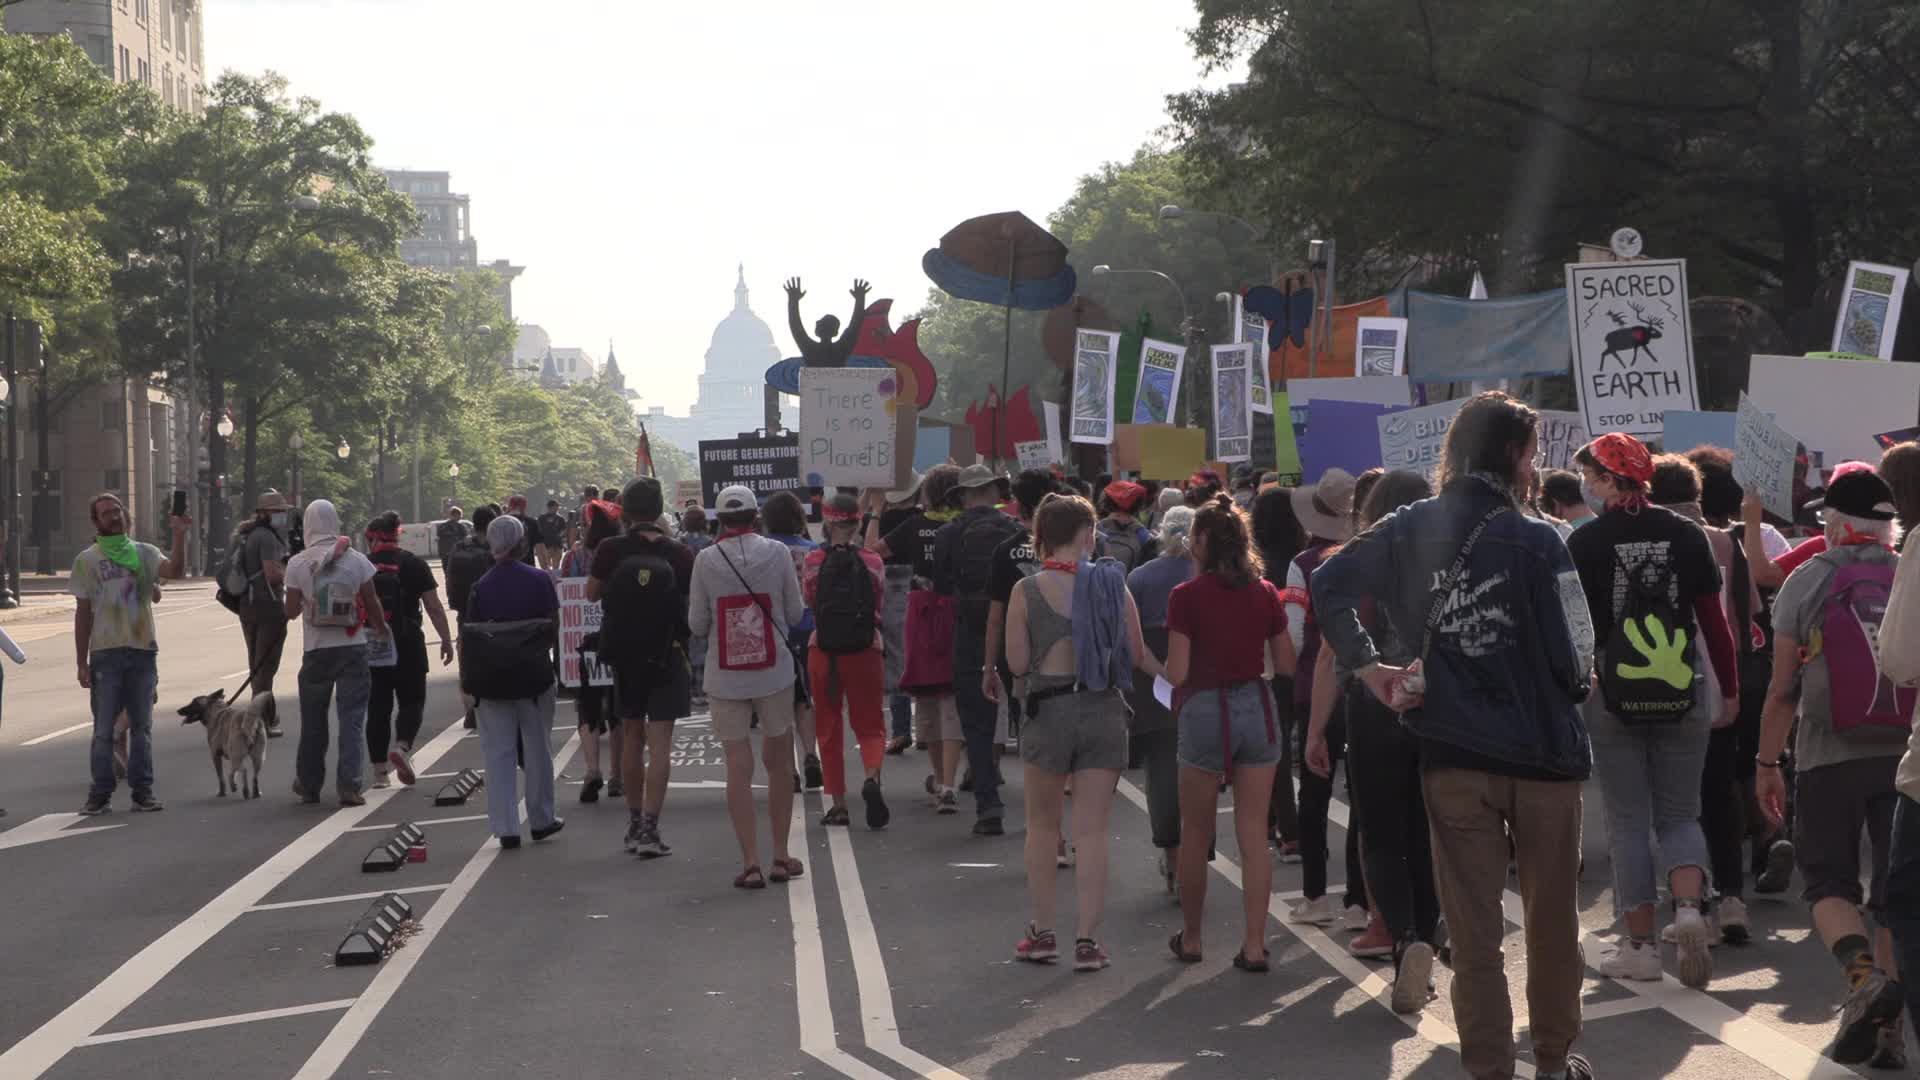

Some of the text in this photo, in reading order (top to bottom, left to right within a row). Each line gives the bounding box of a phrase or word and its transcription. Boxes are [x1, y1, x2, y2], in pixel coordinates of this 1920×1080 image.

[1582, 274, 1675, 300] SACRED
[1593, 370, 1681, 399] EARTH
[812, 384, 873, 410] There
[825, 417, 873, 431] is no
[1599, 412, 1665, 426] STOP LIN
[1415, 416, 1451, 439] BID
[704, 448, 739, 461] FUTURE
[810, 437, 890, 467] Planet B
[1405, 441, 1442, 464] DEC
[733, 463, 774, 477] DESERVE
[713, 482, 720, 494] A
[758, 478, 799, 491] CLIMATE
[1010, 547, 1036, 559] COU
[563, 605, 602, 627] NO REA
[584, 615, 601, 626] ASS
[670, 758, 725, 766] TUR
